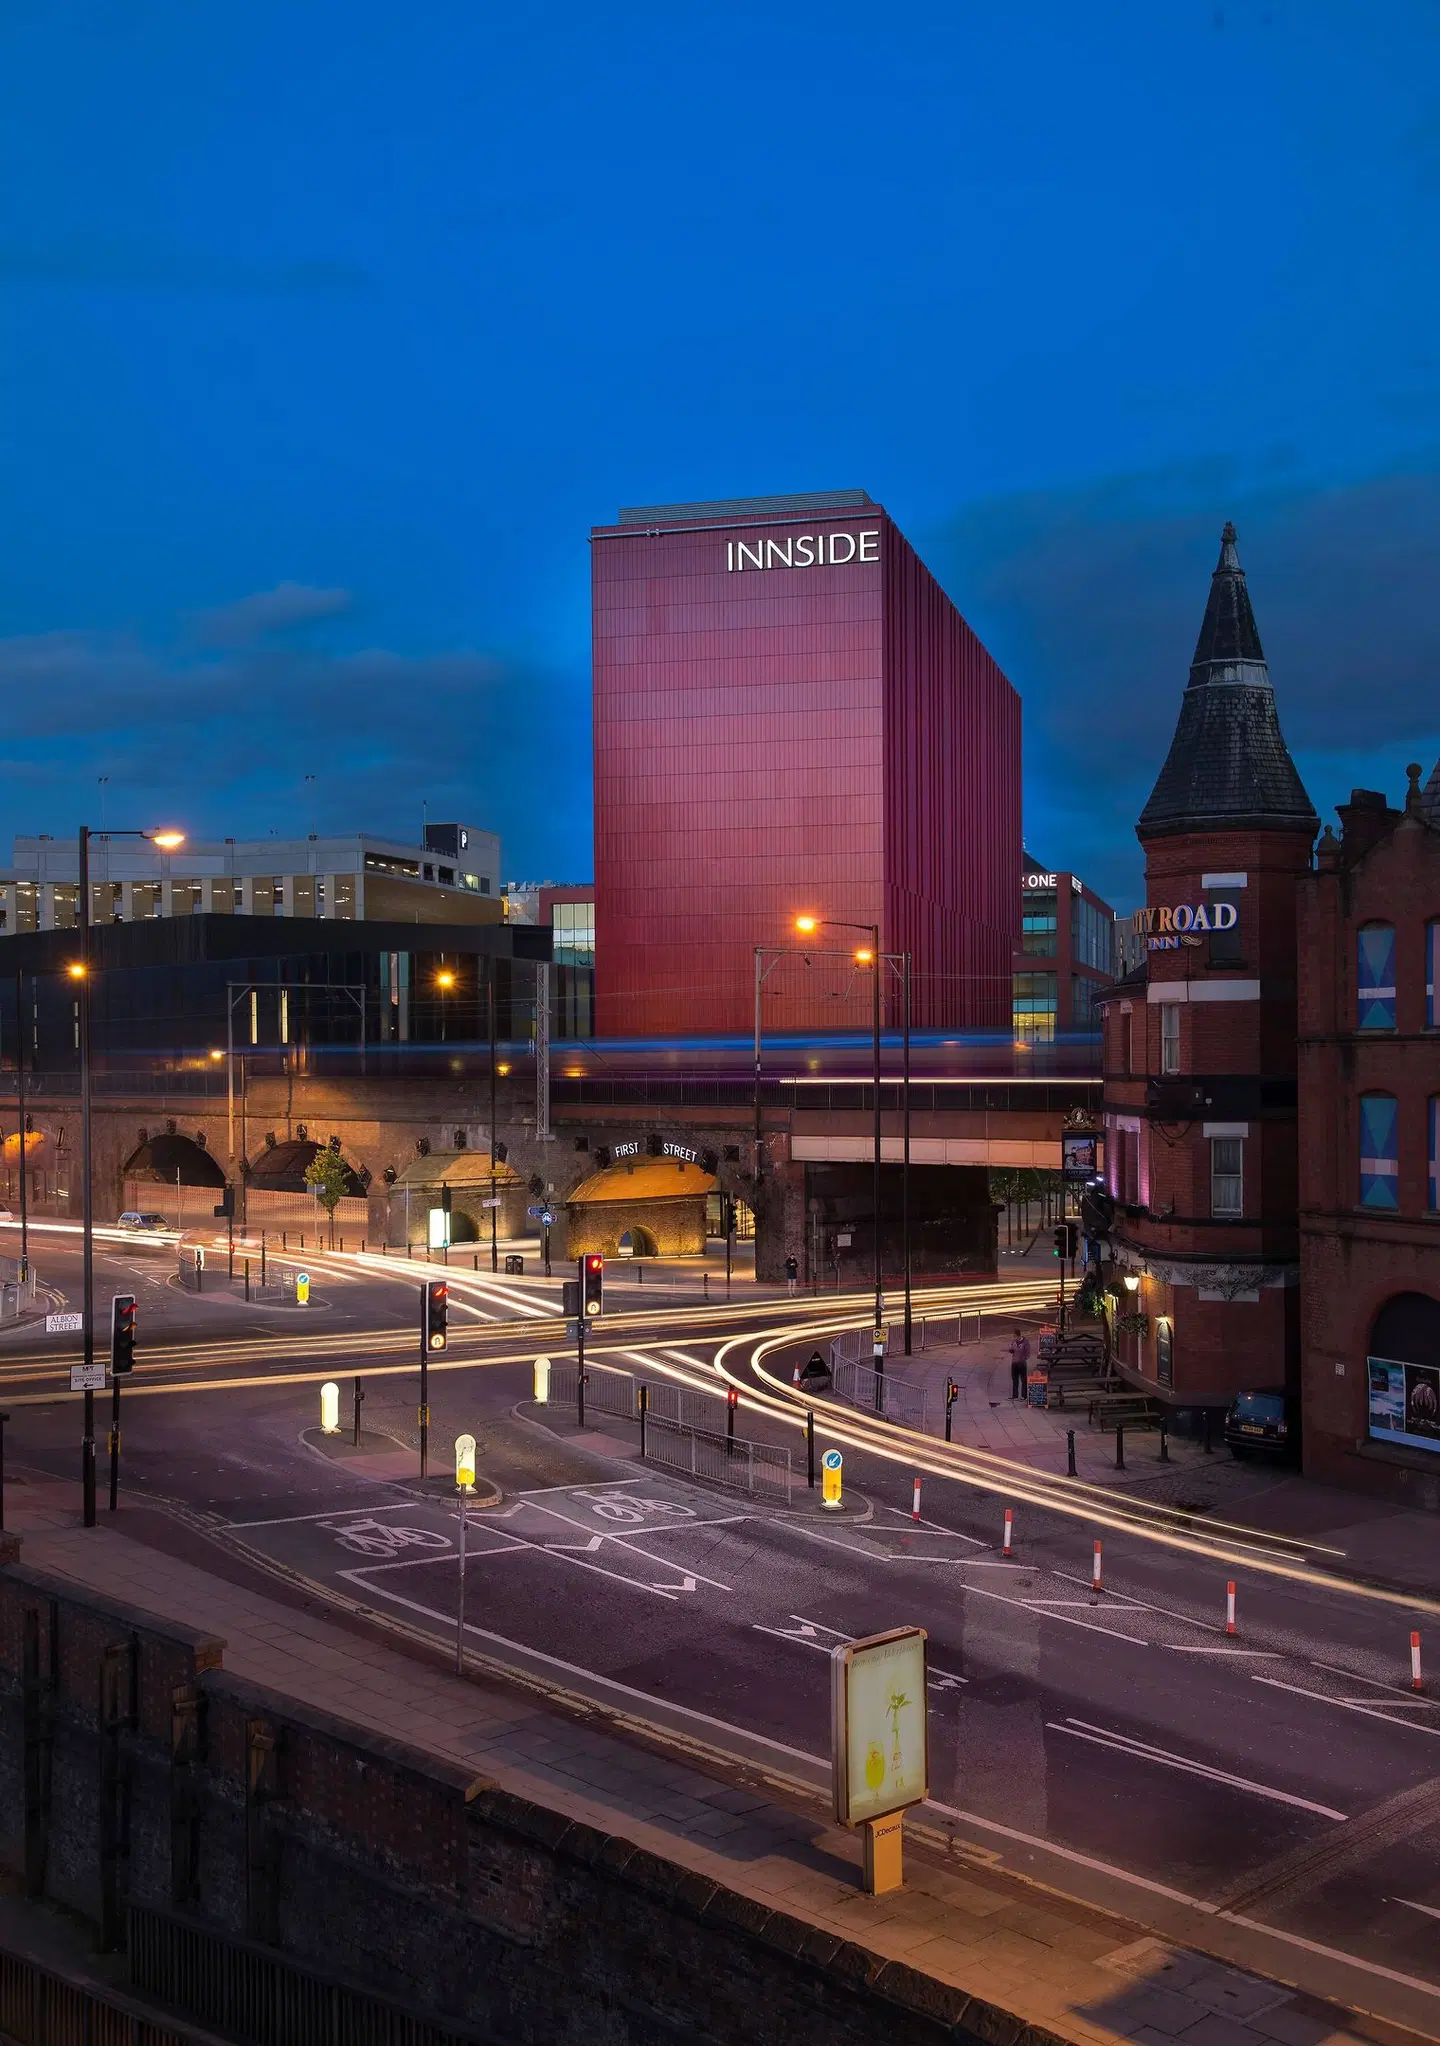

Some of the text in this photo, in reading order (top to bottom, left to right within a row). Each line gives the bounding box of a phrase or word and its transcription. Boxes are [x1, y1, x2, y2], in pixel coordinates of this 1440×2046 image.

[727, 531, 880, 572] INNSIDE
[1028, 874, 1058, 888] ONE
[1158, 903, 1238, 932] ROAD
[1147, 935, 1180, 951] INN
[615, 1142, 698, 1162] FIRST STREET
[50, 1322, 78, 1331] STREET
[51, 1315, 78, 1323] ALBION
[875, 1823, 901, 1838] JCDecaux
